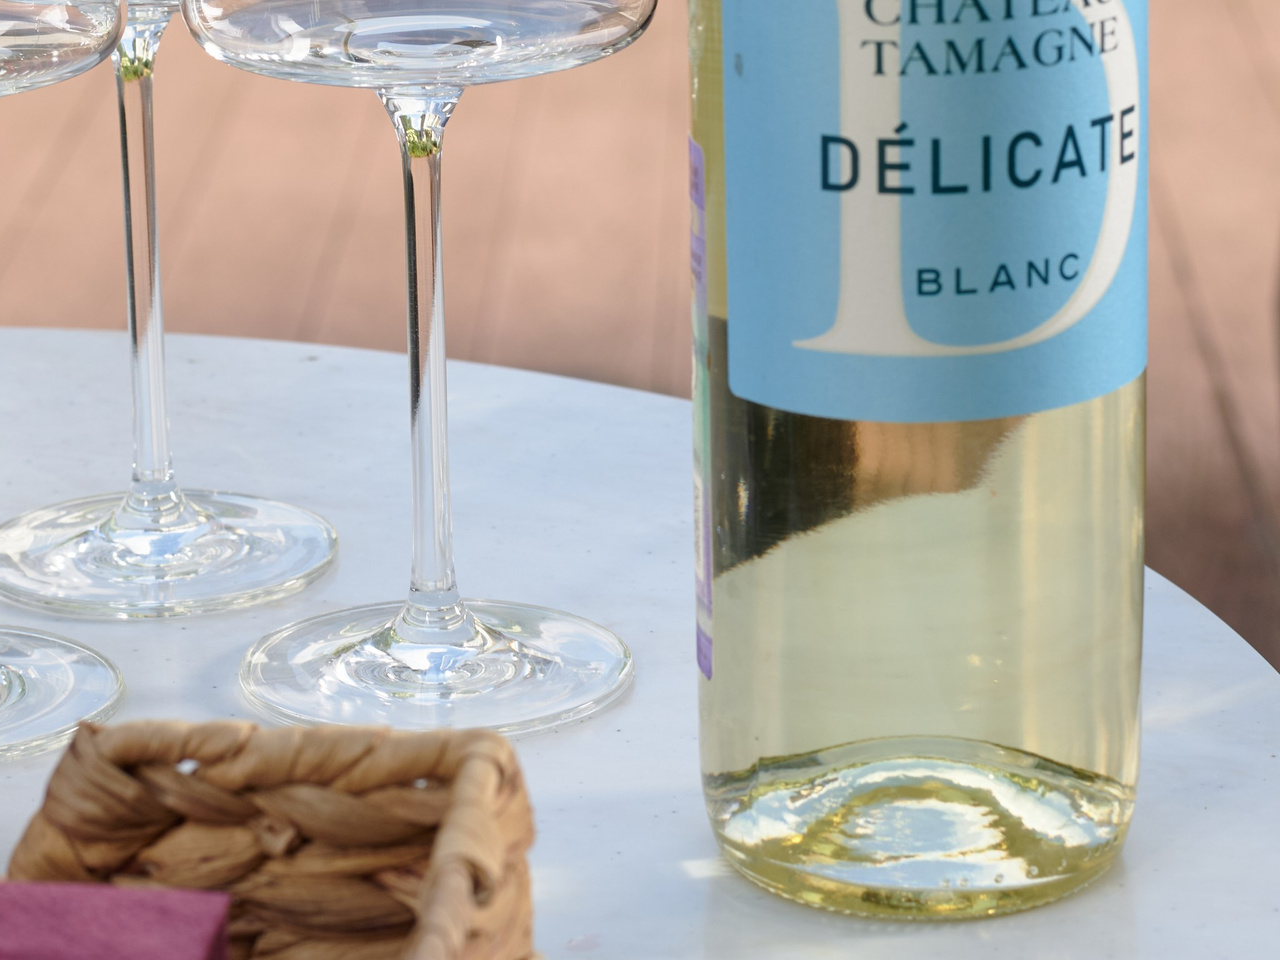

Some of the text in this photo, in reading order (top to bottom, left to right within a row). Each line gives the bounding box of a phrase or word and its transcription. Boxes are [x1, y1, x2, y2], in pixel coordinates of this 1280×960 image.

[860, 16, 1119, 77] TAMAGNE
[820, 104, 1136, 196] DÉLICATE
[916, 253, 1080, 297] BLANC
